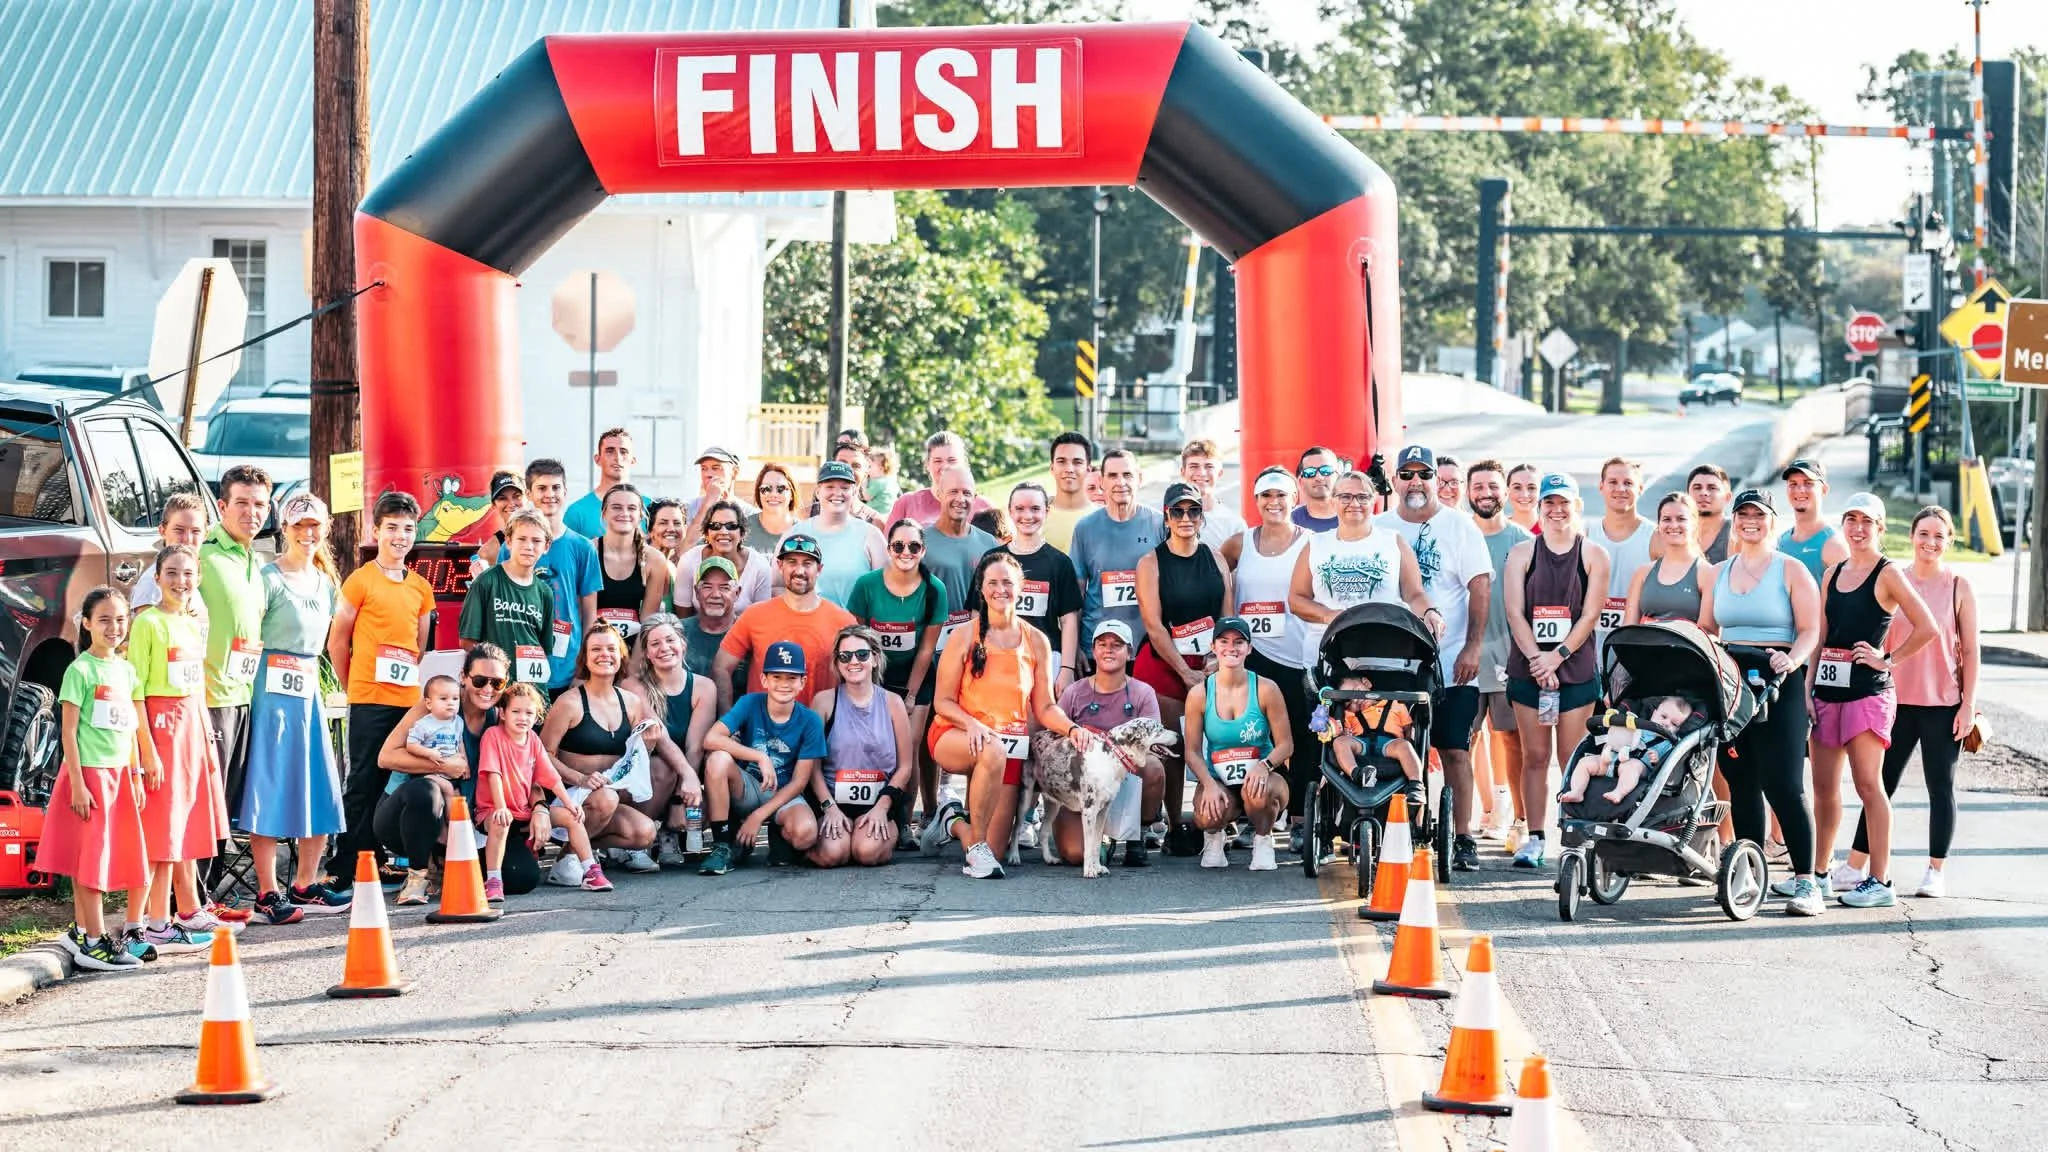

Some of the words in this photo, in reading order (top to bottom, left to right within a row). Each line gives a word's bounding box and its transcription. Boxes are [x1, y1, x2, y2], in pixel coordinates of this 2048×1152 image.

[676, 47, 1063, 156] FINISH
[2014, 347, 2048, 370] Me
[1115, 586, 1136, 602] 72
[494, 598, 525, 616] Bayou
[1015, 596, 1034, 611] 29
[1251, 617, 1272, 634] 26
[1600, 613, 1621, 629] 52
[1537, 622, 1557, 638] 20
[881, 635, 902, 648] 84
[1190, 637, 1200, 653] 1
[241, 657, 256, 675] 93
[390, 663, 410, 682] 97
[529, 662, 543, 678] 44
[1821, 664, 1837, 681] 38
[282, 672, 304, 692] 96
[1225, 764, 1247, 781] 25
[849, 786, 871, 801] 30
